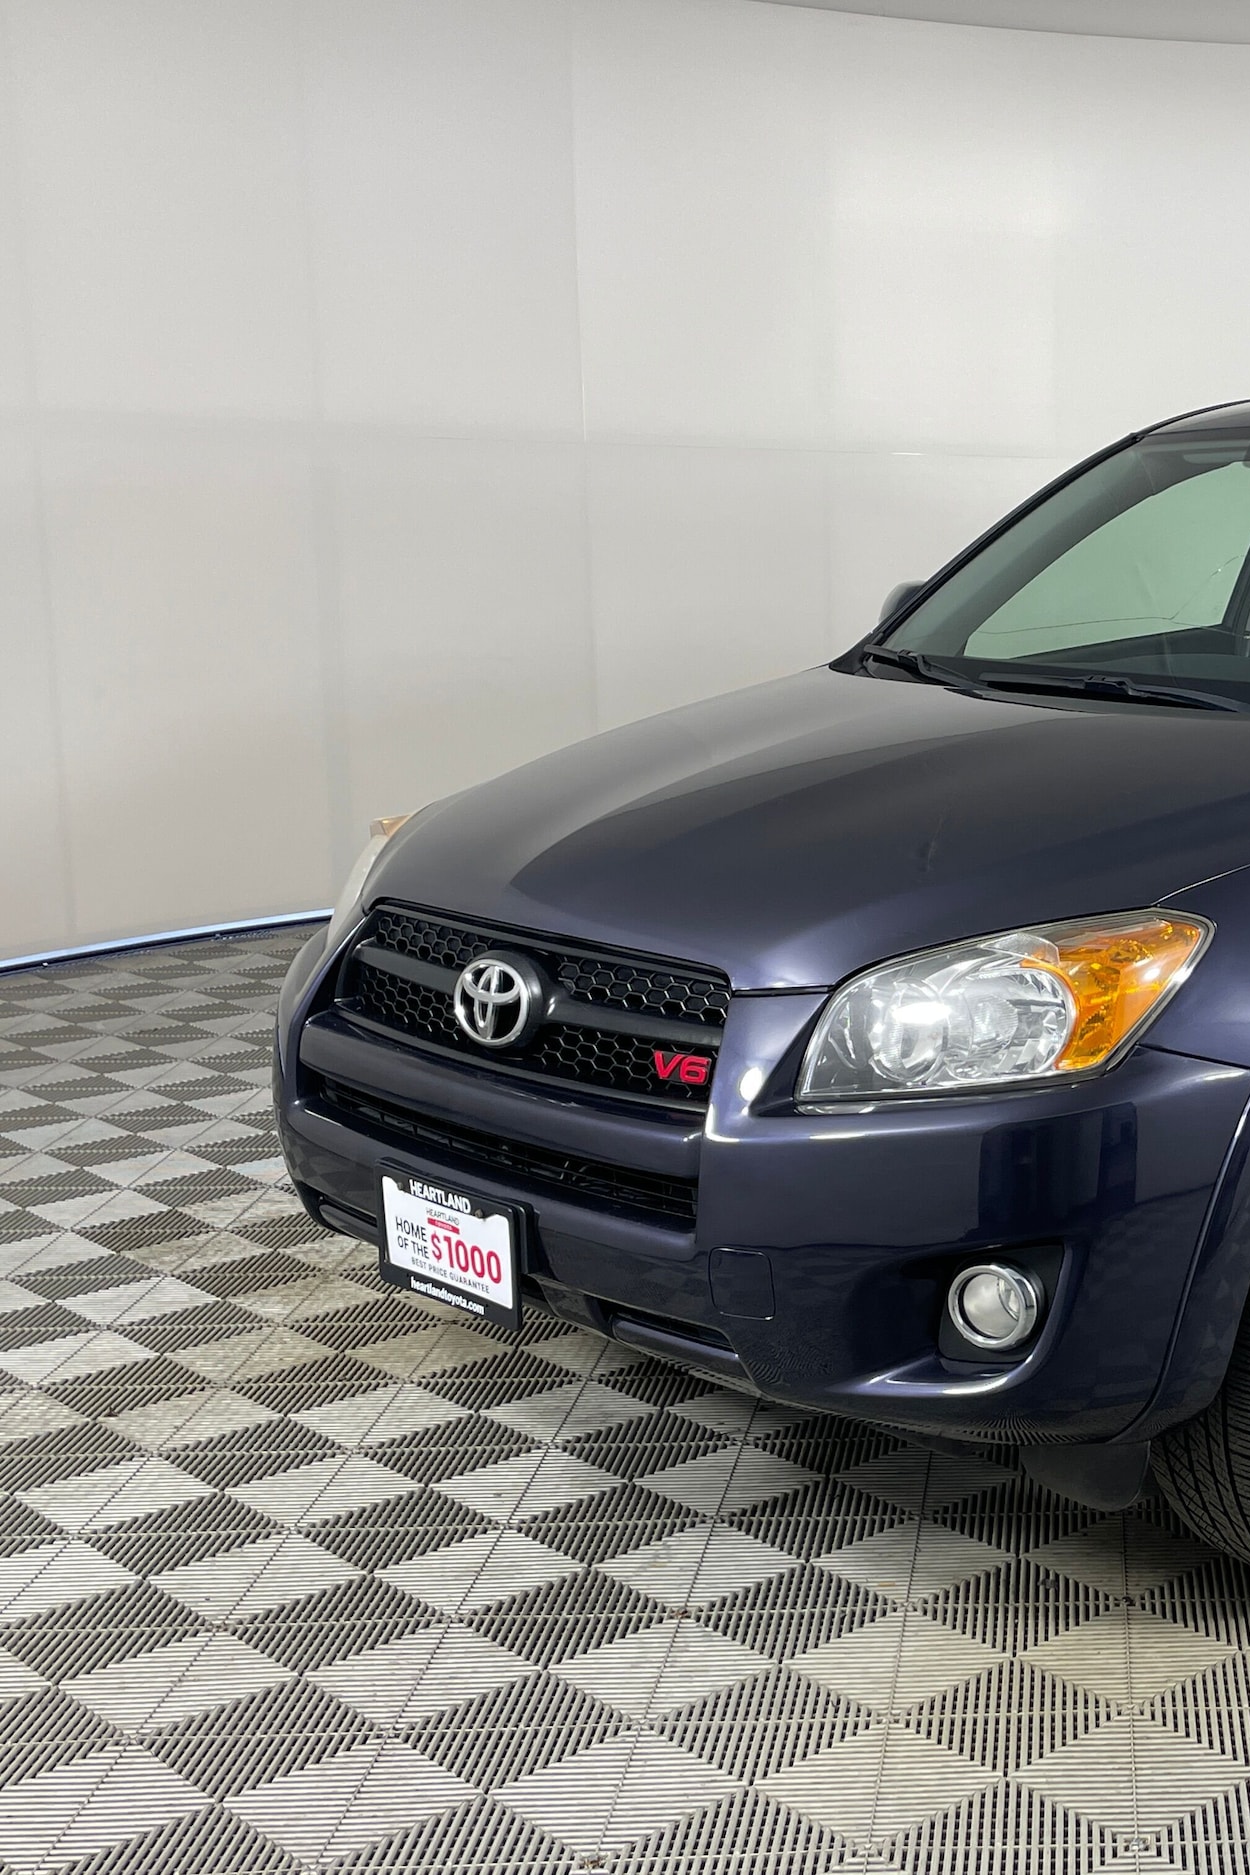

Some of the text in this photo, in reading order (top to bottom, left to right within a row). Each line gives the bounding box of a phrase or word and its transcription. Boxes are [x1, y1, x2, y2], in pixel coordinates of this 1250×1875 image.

[654, 1049, 712, 1085] V6
[409, 1179, 471, 1214] HEARTLAND
[395, 1216, 427, 1243] HOME
[397, 1235, 430, 1259] OF THE
[431, 1230, 502, 1284] $1000
[411, 1257, 490, 1294] BEST PRICE GUARANTEE
[410, 1276, 485, 1315] heartlandtoyota.com
